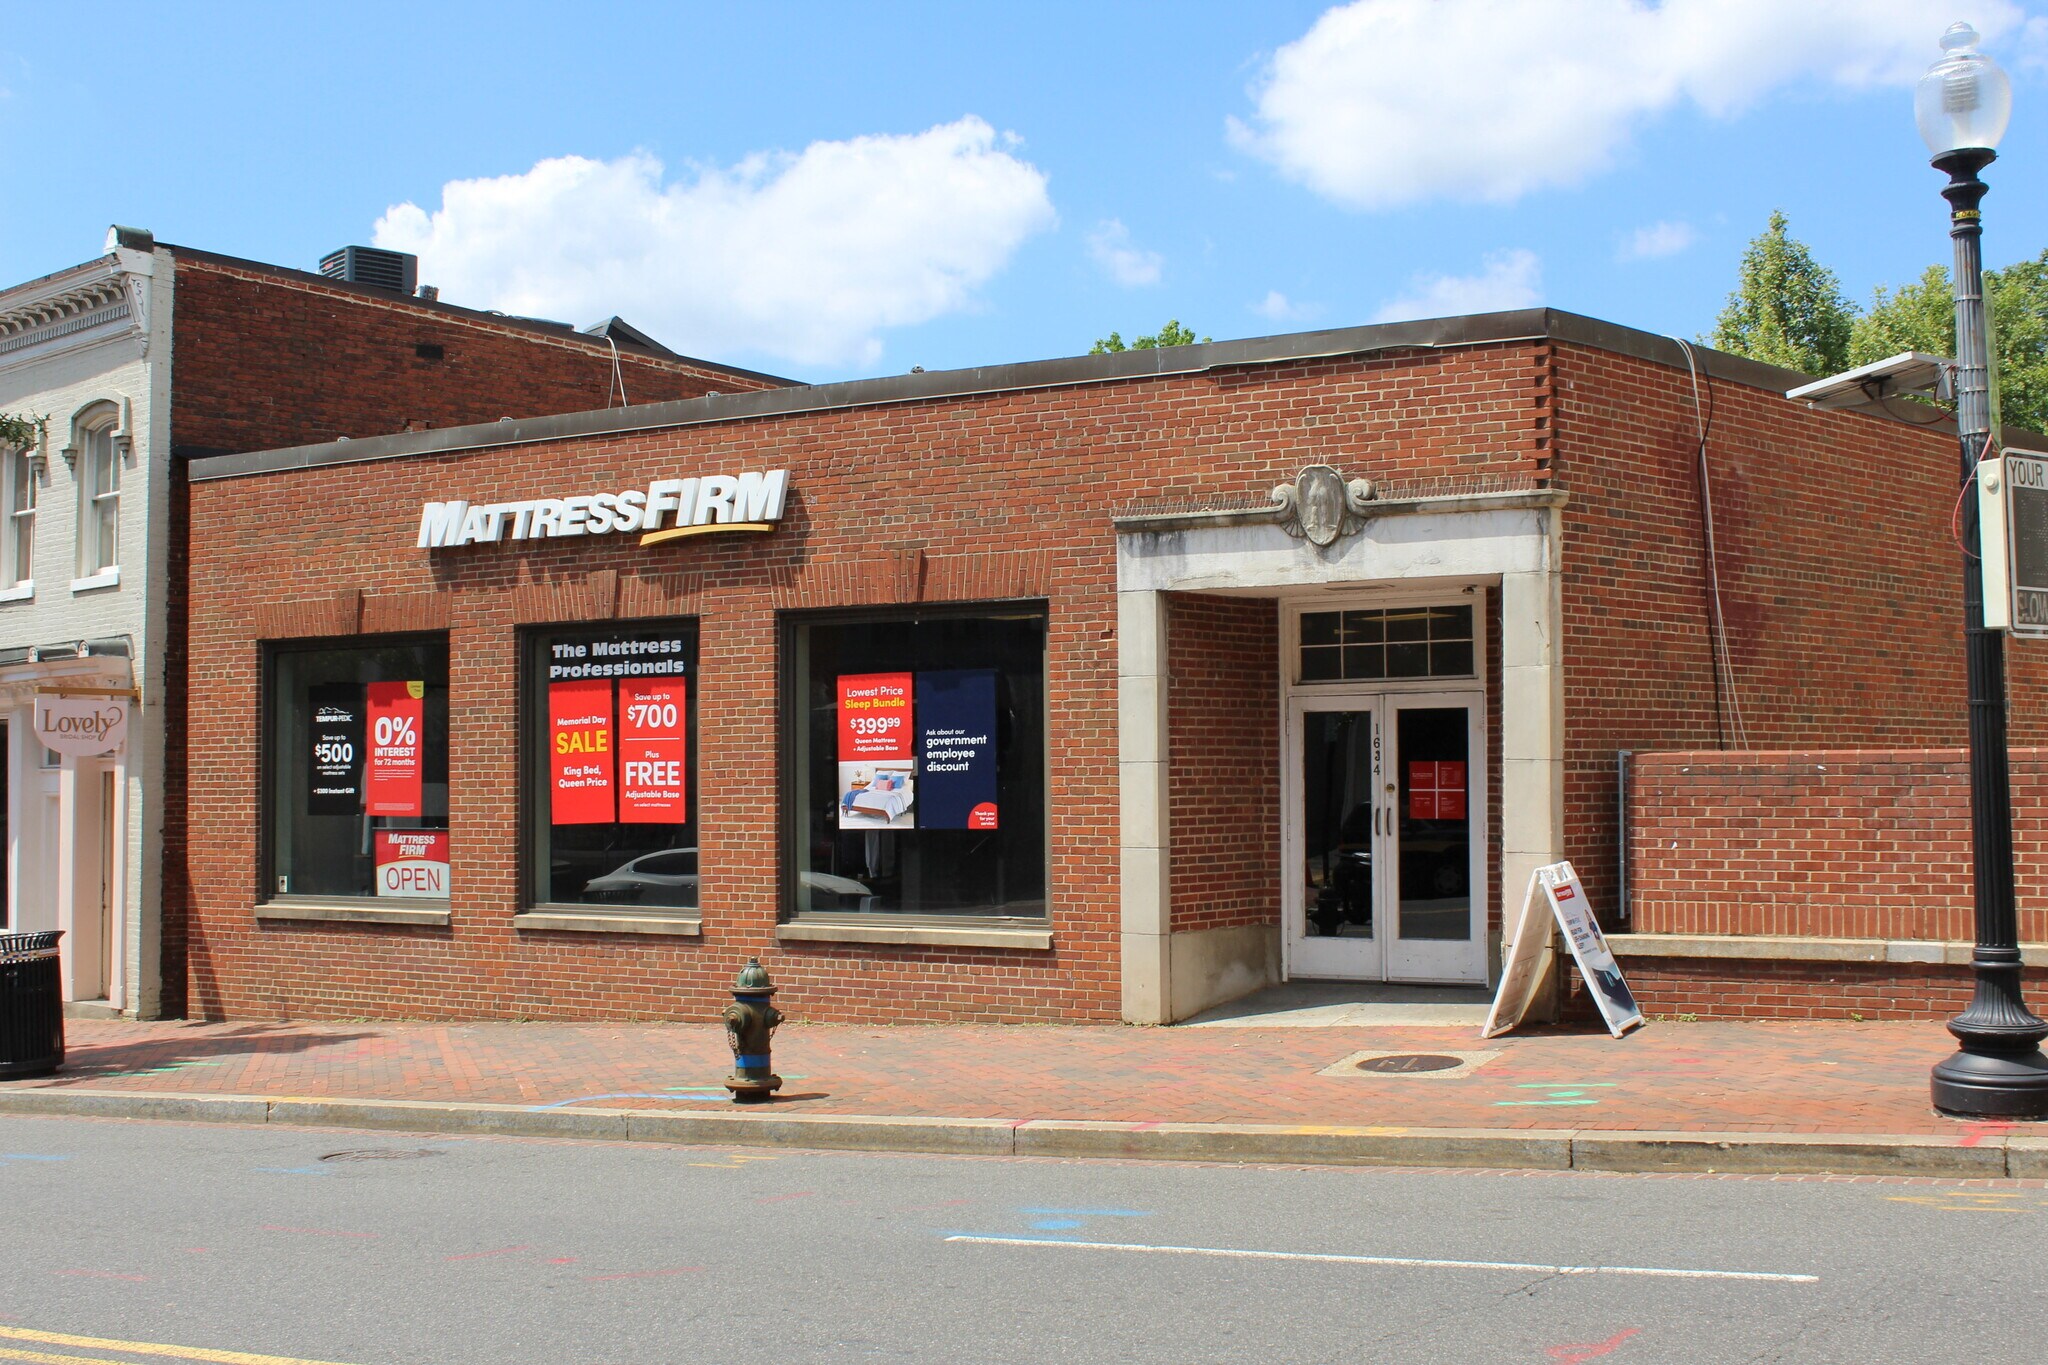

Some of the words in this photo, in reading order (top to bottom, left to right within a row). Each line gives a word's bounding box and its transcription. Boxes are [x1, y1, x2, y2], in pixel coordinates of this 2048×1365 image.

[2009, 460, 2044, 487] YOUR
[552, 644, 587, 658] The
[592, 640, 682, 657] Mattress
[550, 660, 684, 678] Professionals
[634, 693, 652, 701] Save
[652, 694, 662, 702] up
[662, 692, 671, 700] to
[846, 687, 878, 698] Lowest
[880, 686, 904, 696] Price
[845, 698, 871, 711] Sleep
[872, 696, 906, 708] Bundle
[557, 716, 591, 726] Memorial
[591, 715, 606, 725] Day
[627, 704, 677, 728] $700
[42, 706, 123, 741] Lovely
[374, 716, 416, 746] 0%
[556, 730, 608, 754] SALE
[926, 735, 987, 749] government
[315, 743, 353, 763] $500
[374, 747, 416, 757] INTEREST
[926, 748, 975, 761] employee
[1373, 723, 1381, 776] 1634
[374, 758, 383, 766] for
[383, 758, 392, 766] 72
[391, 758, 416, 766] months
[926, 761, 970, 772] discount
[563, 766, 582, 777] King
[583, 765, 602, 775] Bed,
[625, 761, 681, 786] FREE
[558, 778, 585, 788] Queen
[586, 777, 607, 786] Price
[625, 790, 661, 800] Adjustable
[662, 790, 680, 798] Base
[388, 833, 436, 844] MATTRESS
[399, 845, 426, 855] FIRM
[386, 867, 440, 891] OPEN
